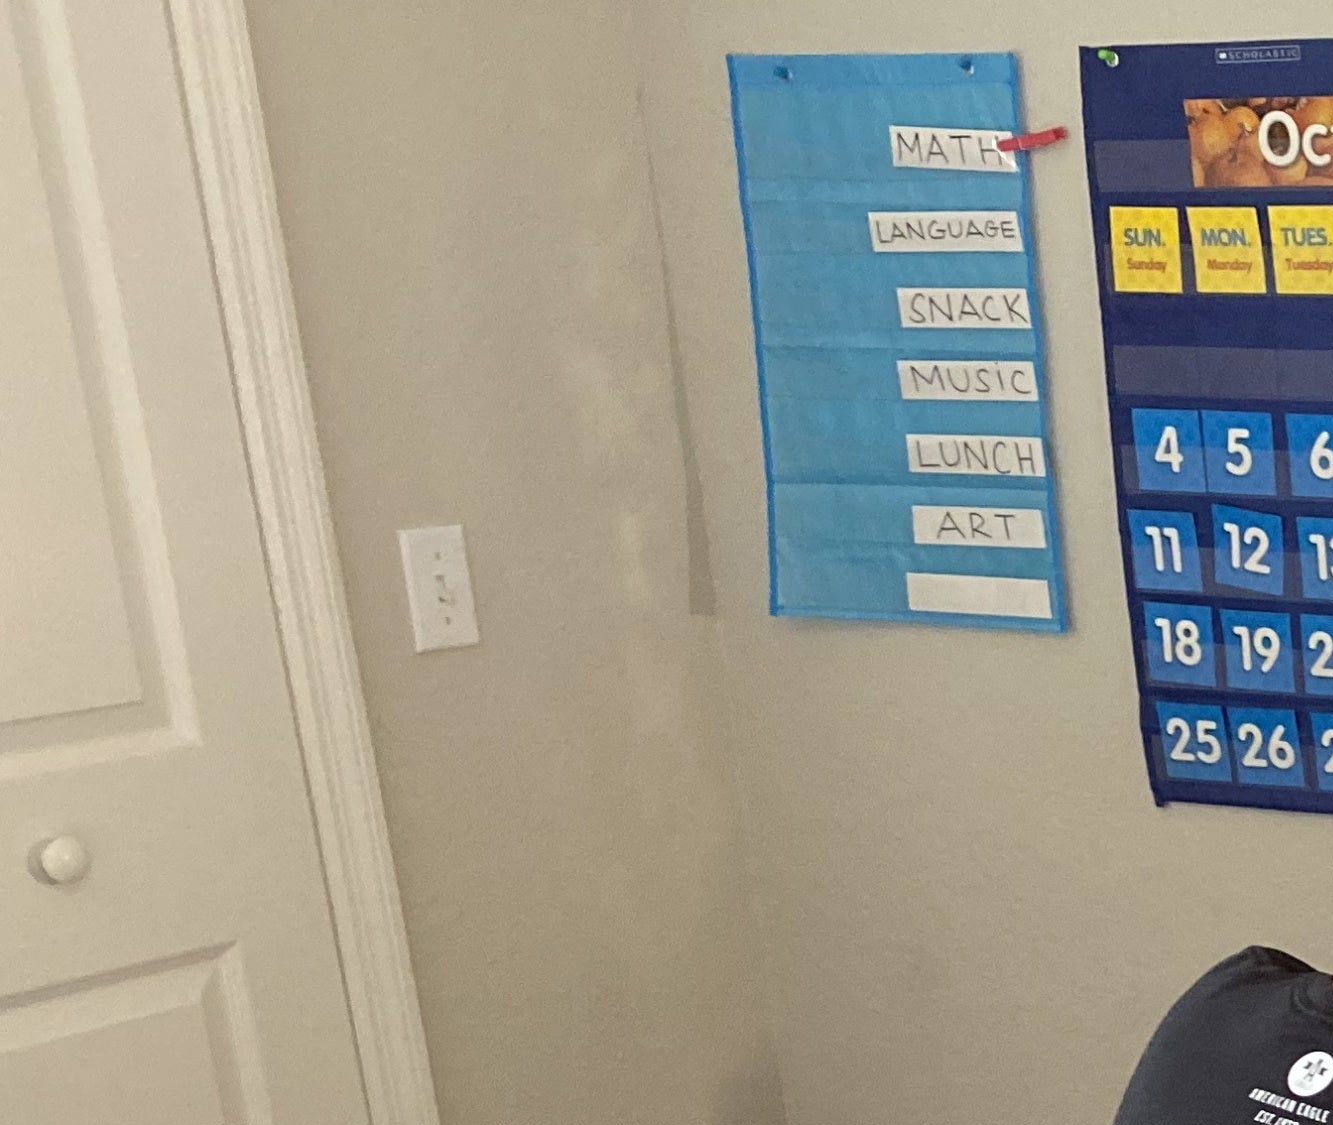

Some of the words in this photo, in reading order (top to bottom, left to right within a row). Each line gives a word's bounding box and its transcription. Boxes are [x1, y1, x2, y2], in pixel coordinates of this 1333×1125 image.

[1228, 49, 1298, 60] SCHOLASTIC
[896, 131, 1003, 166] MATH
[875, 219, 1017, 244] LANGUAGE
[1123, 227, 1166, 248] SUN.
[1200, 227, 1252, 247] MON.
[1280, 227, 1333, 248] TUES.
[1126, 257, 1167, 274] Sunday
[1206, 258, 1253, 274] Monday
[908, 292, 1028, 324] SNACK
[914, 439, 1037, 475] LUNCH
[1153, 425, 1184, 474] 4
[1224, 427, 1253, 477] 5
[936, 511, 1017, 541] ART
[1145, 525, 1183, 574] 11
[1222, 522, 1271, 575] 12
[1153, 616, 1202, 667] 18
[1232, 624, 1281, 674] 19
[1164, 716, 1223, 765] 25
[1236, 721, 1296, 770] 26
[1248, 1087, 1298, 1113] AMERICAN
[1295, 1102, 1331, 1124] EAGLE
